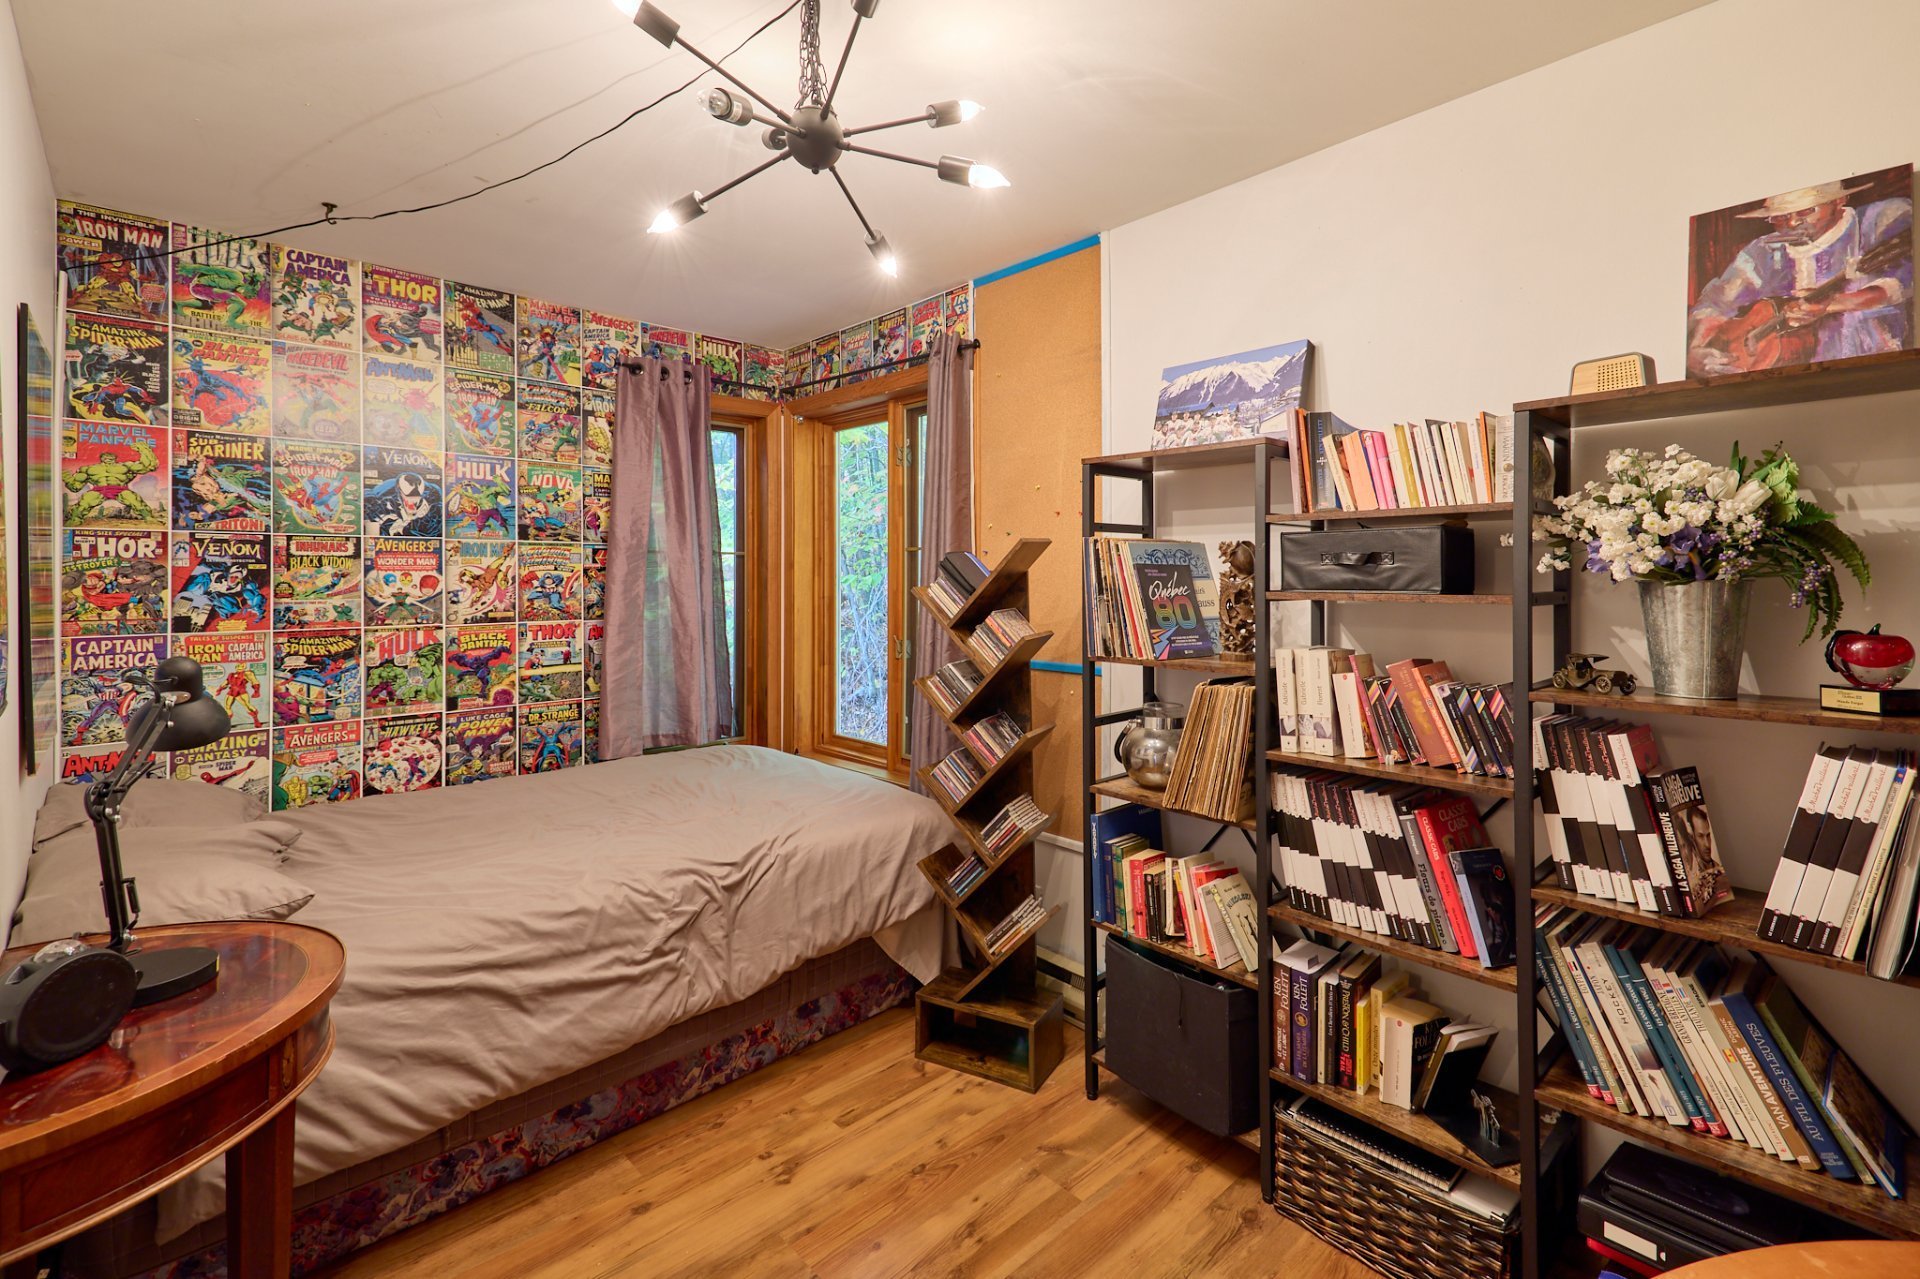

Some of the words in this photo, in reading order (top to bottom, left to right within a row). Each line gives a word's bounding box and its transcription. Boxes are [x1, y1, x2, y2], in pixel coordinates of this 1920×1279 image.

[77, 210, 96, 218] THE
[101, 212, 155, 229] INVINCIBLE
[75, 216, 118, 241] IRON
[124, 224, 163, 249] MAN
[286, 250, 348, 272] CAPTAIN
[284, 263, 351, 286] AMERICA
[373, 277, 437, 304] THOR
[464, 287, 497, 297] AMAZING
[529, 299, 574, 316] MARVEL
[529, 310, 578, 324] FANFARE
[92, 323, 147, 337] AMAZING
[590, 312, 635, 331] AVENGERS
[70, 326, 164, 350] SPIDER-MAN
[649, 331, 688, 346] DAREDEVIL
[192, 349, 269, 367] PANTHER
[202, 342, 263, 357] BLACK
[702, 341, 739, 363] HULK
[286, 352, 350, 371] DAREDEVIL
[365, 358, 434, 382] ANT-MAN
[449, 381, 504, 397] SPIDER-MAN
[528, 403, 569, 414] FALCON
[80, 423, 150, 437] MARVEL
[189, 437, 226, 447] SUB-
[188, 444, 265, 461] MARINER
[279, 451, 346, 470] SPIDER-MAN
[382, 450, 432, 469] VENOM
[290, 465, 314, 477] IRON
[457, 460, 511, 483] HULK
[531, 474, 574, 493] NOVA
[215, 519, 265, 531] TRITON!
[80, 537, 157, 559] THOR
[192, 539, 261, 558] VENOM
[296, 541, 349, 552] INHUMANS
[375, 539, 434, 552] AVENGERS
[459, 543, 488, 557] IRON
[290, 556, 320, 569] BLACK
[322, 556, 352, 569] WIDOW
[377, 557, 413, 566] WONDER
[416, 557, 436, 566] MAN
[1149, 571, 1191, 600] Québec
[1153, 596, 1197, 629] 80
[300, 636, 342, 645] AMAZING
[460, 633, 508, 642] BLACK
[528, 624, 576, 641] THOR
[75, 638, 154, 655] CAPTAIN
[188, 644, 224, 654] IRON
[227, 643, 264, 653] CAPTAIN
[283, 639, 356, 656] SPIDER-MAN
[378, 629, 440, 661] HULK
[460, 641, 511, 651] PANTHER
[73, 648, 159, 671] AMERICA
[188, 653, 222, 663] MAN
[228, 651, 263, 661] AMERICA
[457, 717, 512, 730] POWER
[528, 712, 541, 722] DR.
[540, 709, 578, 720] STRANGE
[290, 731, 349, 747] AVENGERS
[384, 724, 434, 737] HAWKEYE
[463, 726, 499, 737] MAN
[188, 750, 246, 763] FANTASY
[1422, 817, 1434, 842] CLASSIC
[1430, 841, 1440, 860] CARS
[1659, 812, 1680, 856] VILLENEUVE
[1673, 857, 1687, 878] SAGA
[1418, 863, 1431, 893] Fleurs
[1680, 880, 1689, 892] LA
[1428, 894, 1435, 907] de
[1431, 909, 1444, 938] pierre
[1280, 969, 1289, 1010] FOLLETT
[1293, 983, 1301, 1000] KEN
[1300, 976, 1308, 1011] FOLLETT
[1689, 984, 1705, 1008] ESPAGNE
[1342, 990, 1350, 1022] PRESTON
[1602, 979, 1628, 1024] HOCKEY
[1657, 991, 1681, 1021] BRETAGNE
[1671, 996, 1688, 1021] ANTILLES
[1645, 1021, 1653, 1030] LES
[1655, 1017, 1663, 1026] LES
[1719, 1017, 1737, 1043] DOMINIC
[1342, 1029, 1350, 1052] CHILD
[1674, 1021, 1692, 1044] GRANDE
[1746, 1023, 1785, 1076] FLEUVES
[1736, 1046, 1777, 1105] AVENTURE
[1779, 1078, 1800, 1101] DES
[1771, 1107, 1790, 1130] VAN
[1795, 1103, 1813, 1122] FIL
[1806, 1121, 1824, 1142] AU
